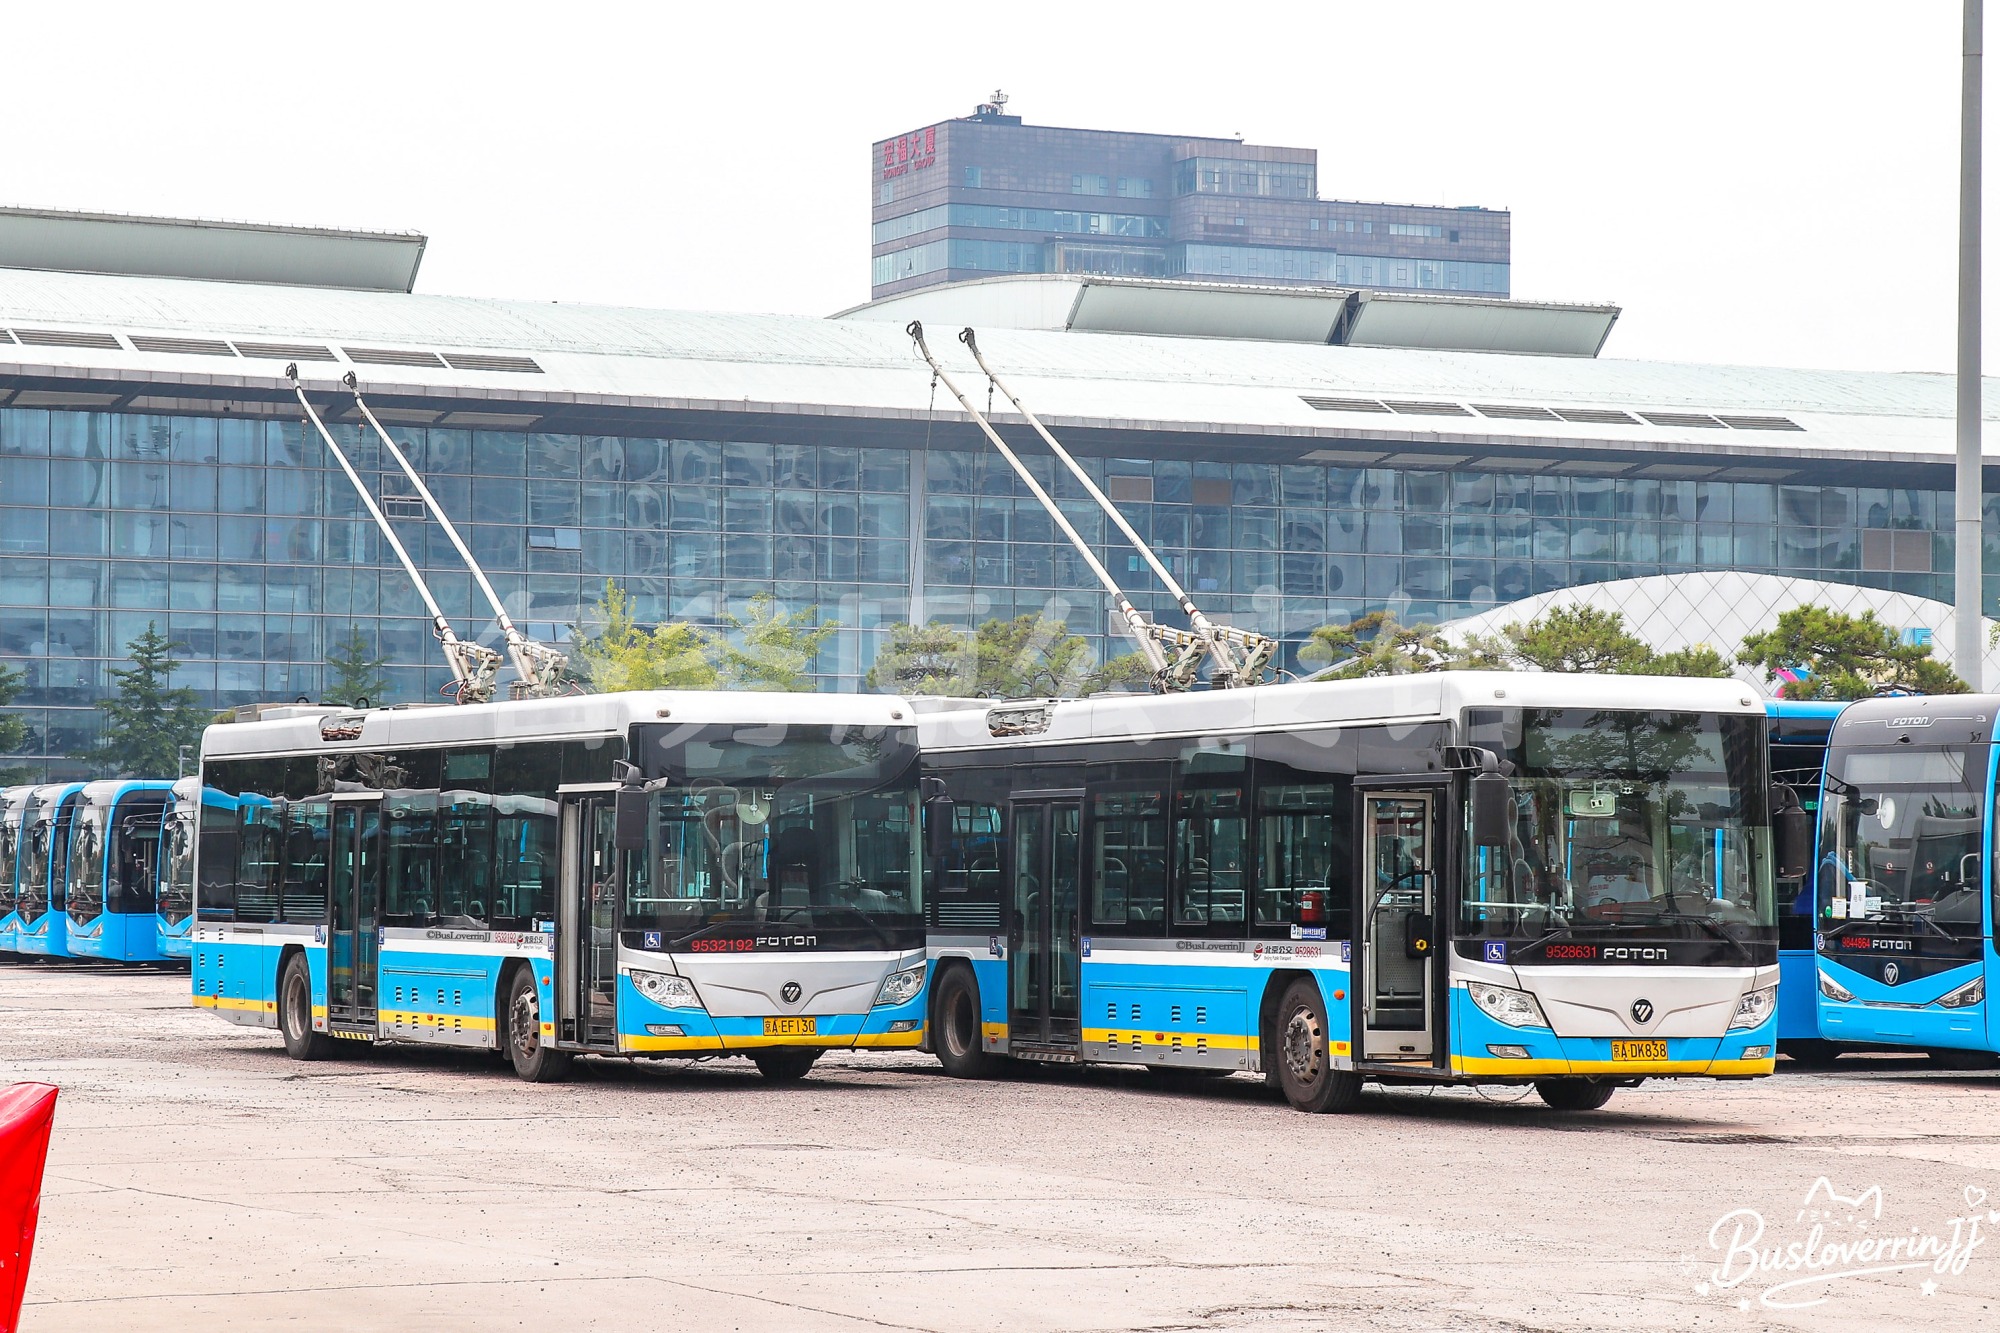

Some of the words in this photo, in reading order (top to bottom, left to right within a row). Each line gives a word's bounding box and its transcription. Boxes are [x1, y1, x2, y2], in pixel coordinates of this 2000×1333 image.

[883, 127, 935, 166] 宏福大厦
[914, 156, 935, 171] GROUP
[1892, 716, 1929, 726] FOTON
[691, 939, 754, 952] 9532192
[756, 935, 818, 947] FOTON
[1264, 945, 1293, 955] 北京公交
[1872, 939, 1912, 950] FOTON
[1294, 946, 1322, 958] 9528631
[1545, 945, 1597, 959] 9528631
[1603, 947, 1668, 960] FOTON
